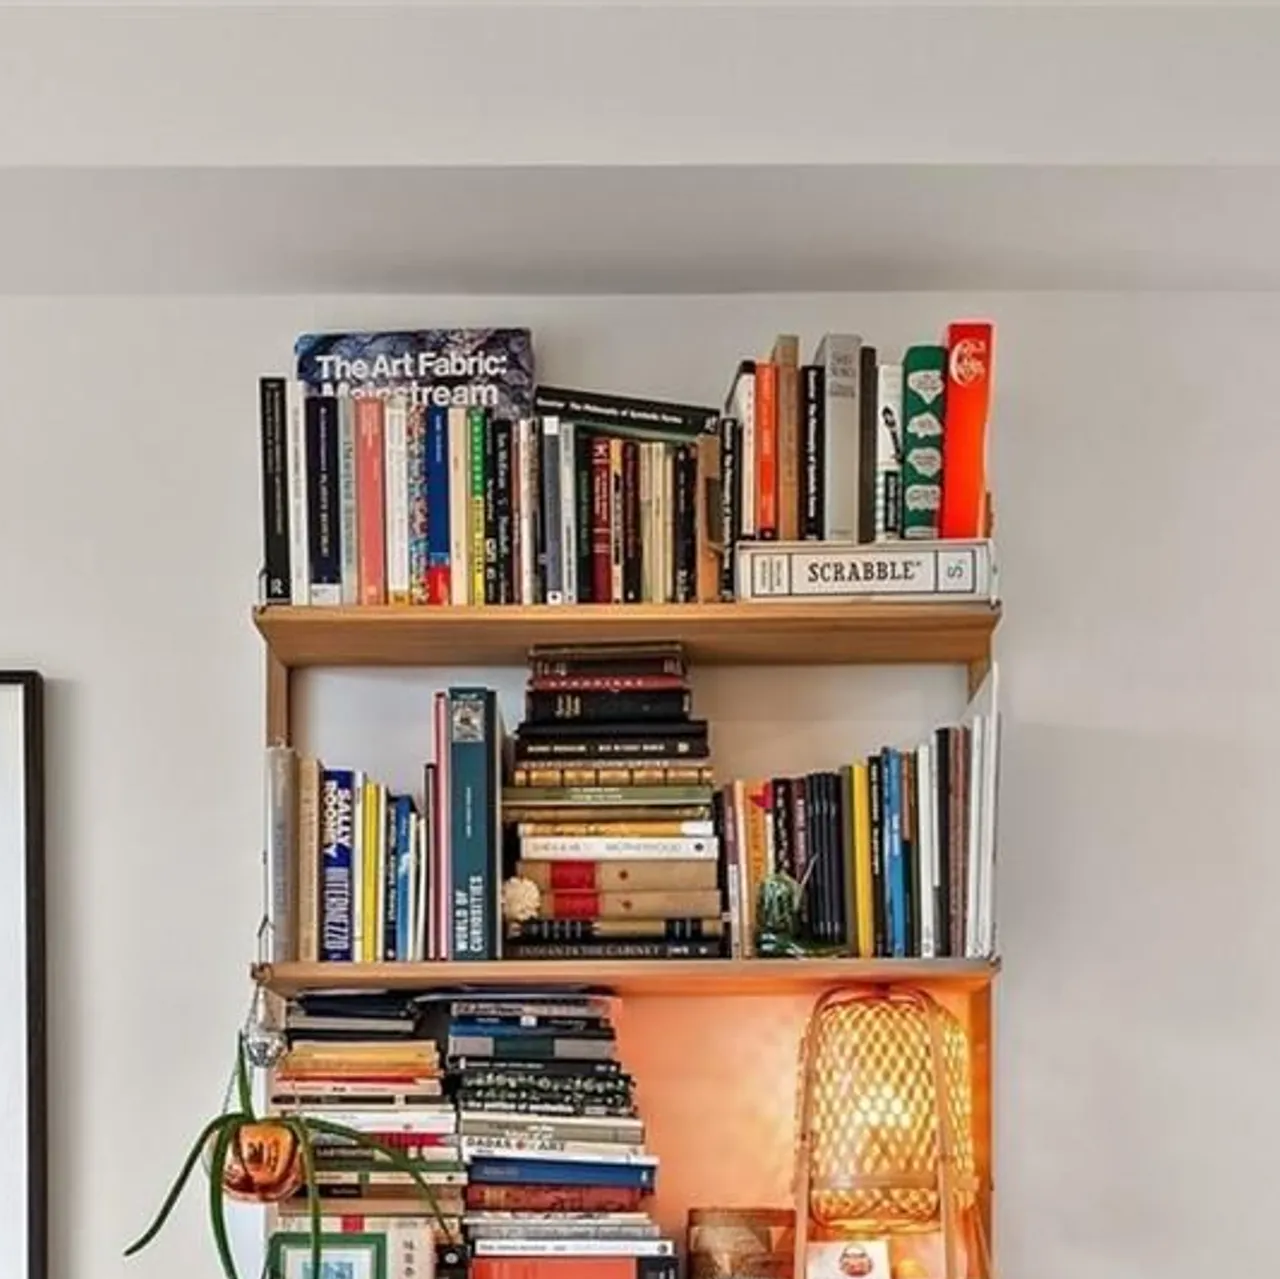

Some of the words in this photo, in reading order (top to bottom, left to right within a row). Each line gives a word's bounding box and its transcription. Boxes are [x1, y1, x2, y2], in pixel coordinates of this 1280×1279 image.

[316, 355, 368, 378] The
[370, 354, 414, 377] Art
[419, 351, 508, 377] Fabric:
[322, 382, 499, 407] Mainstream
[323, 781, 338, 858] ROONEY
[336, 787, 352, 848] SALLY
[323, 870, 350, 950] INTERMEZZO
[456, 890, 470, 909] OF
[470, 875, 483, 951] CURIOSITIES
[456, 912, 470, 951] WORLD
